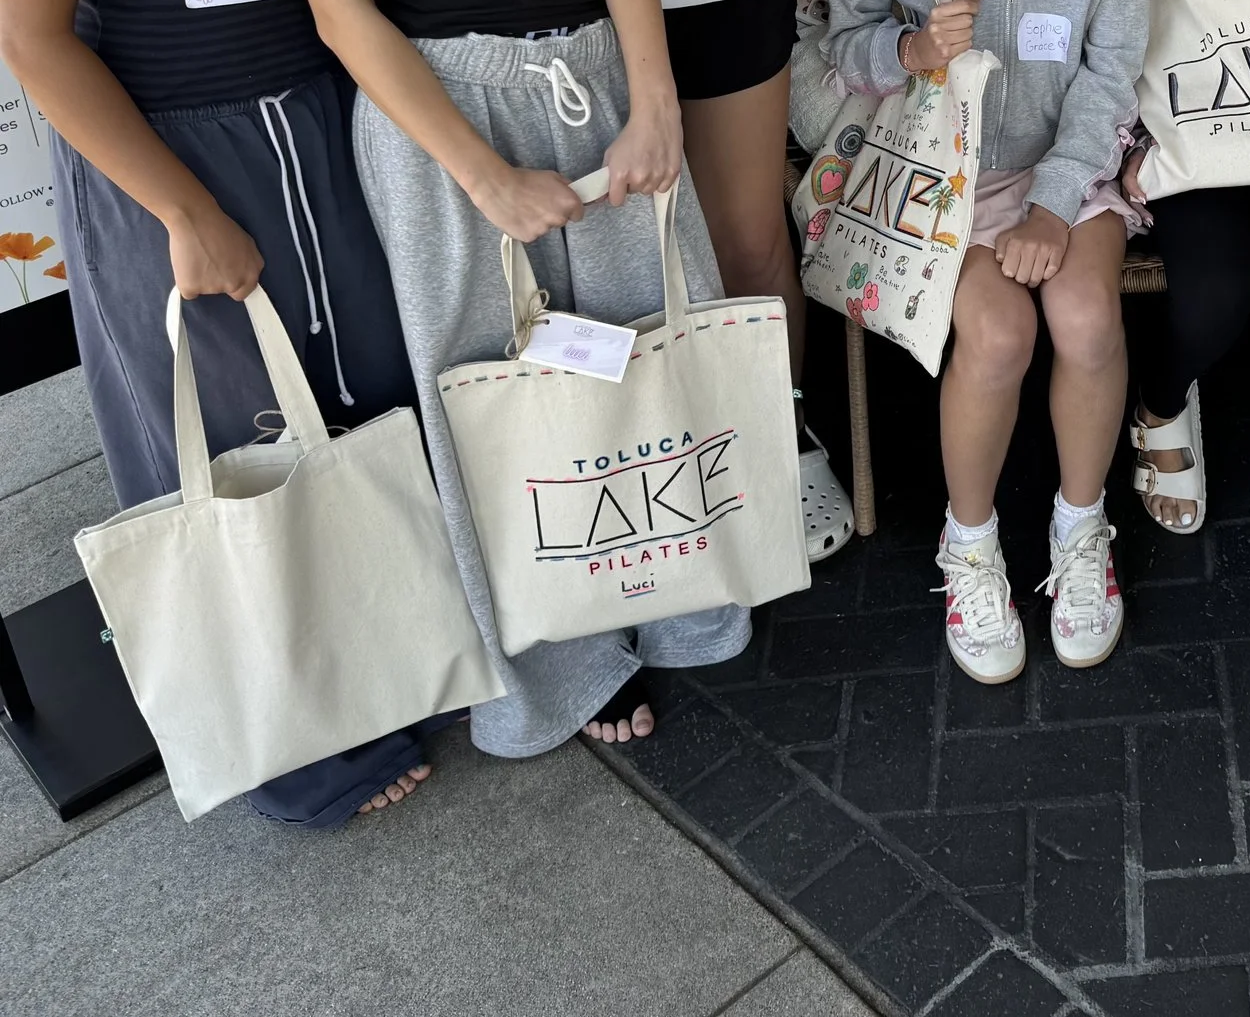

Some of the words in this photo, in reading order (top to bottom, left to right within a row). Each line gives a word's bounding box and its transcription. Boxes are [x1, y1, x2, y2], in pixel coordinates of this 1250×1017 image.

[1026, 19, 1063, 39] Sophie
[1026, 40, 1056, 52] Grace
[874, 124, 918, 154] TOLUCA
[834, 223, 887, 260] PILATES
[930, 242, 949, 254] boba
[572, 430, 694, 474] TOLUCA
[533, 437, 739, 551] LAKE
[589, 536, 707, 575] PILATES
[621, 572, 655, 594] Luci
